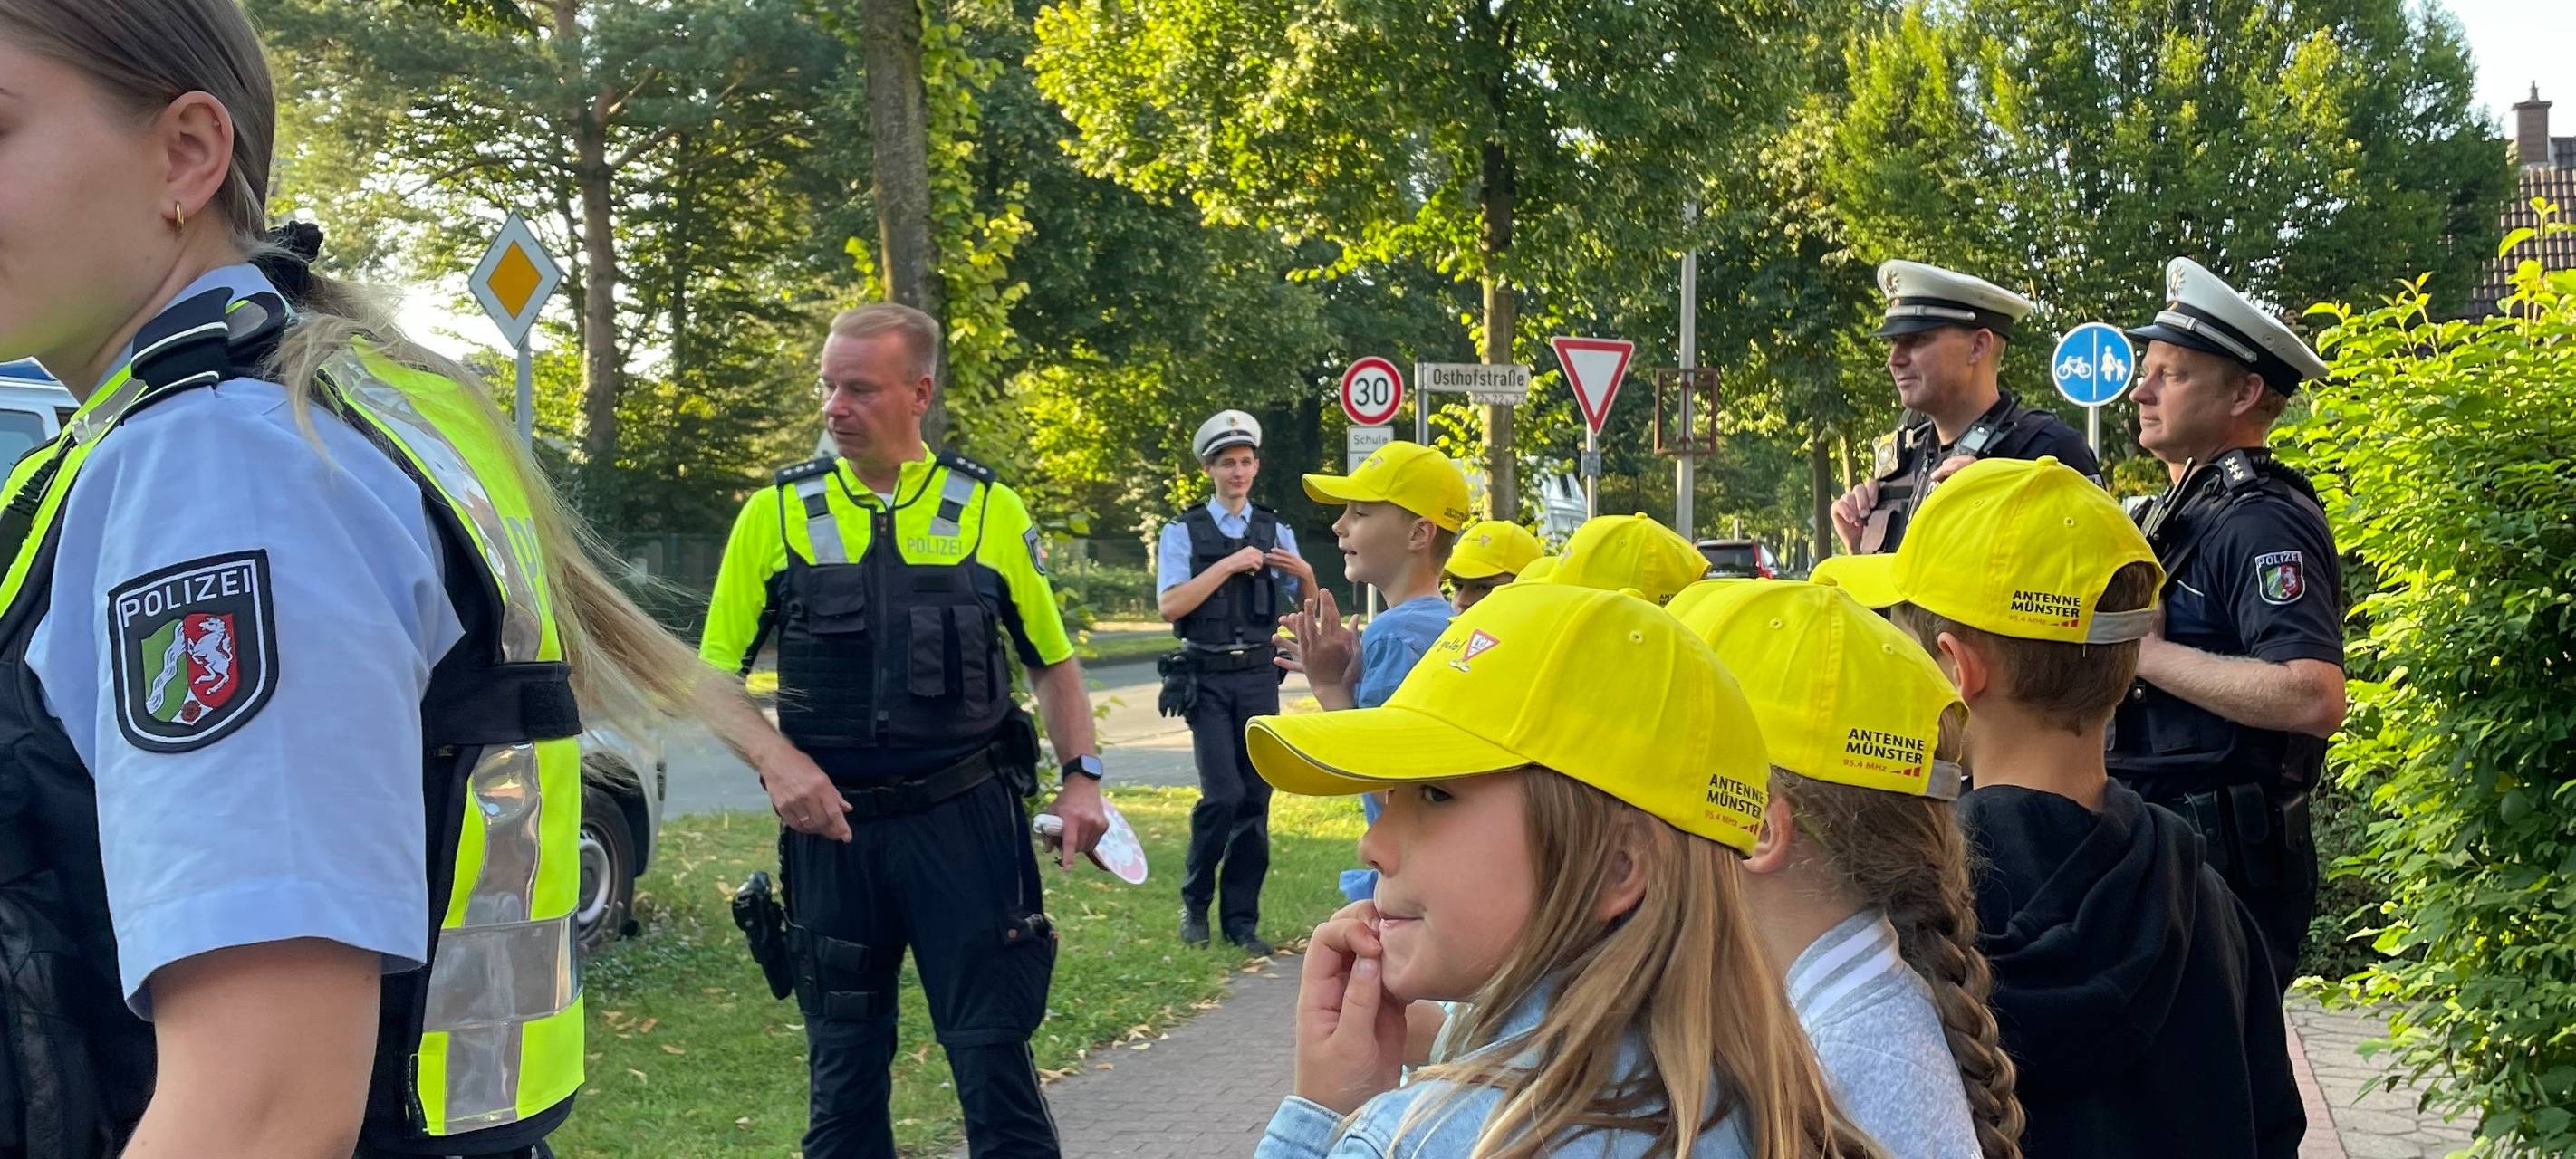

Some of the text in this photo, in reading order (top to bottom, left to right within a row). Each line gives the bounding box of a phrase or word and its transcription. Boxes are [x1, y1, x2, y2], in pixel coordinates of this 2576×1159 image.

[1433, 369, 1524, 386] Osthofstraße
[1354, 377, 1388, 407] 30
[1353, 434, 1388, 445] Schule
[907, 536, 963, 556] POLIZEI
[2257, 552, 2302, 569] POLIZEI
[120, 568, 251, 627] POLIZEI
[2013, 590, 2081, 607] ANTENNE
[2010, 601, 2080, 618] MÜNSTER
[1848, 728, 1925, 752] ANTENNE
[1845, 742, 1923, 764] MÜNSTER
[1843, 759, 1863, 769] 95.4
[1709, 773, 1764, 804] ANTENNE
